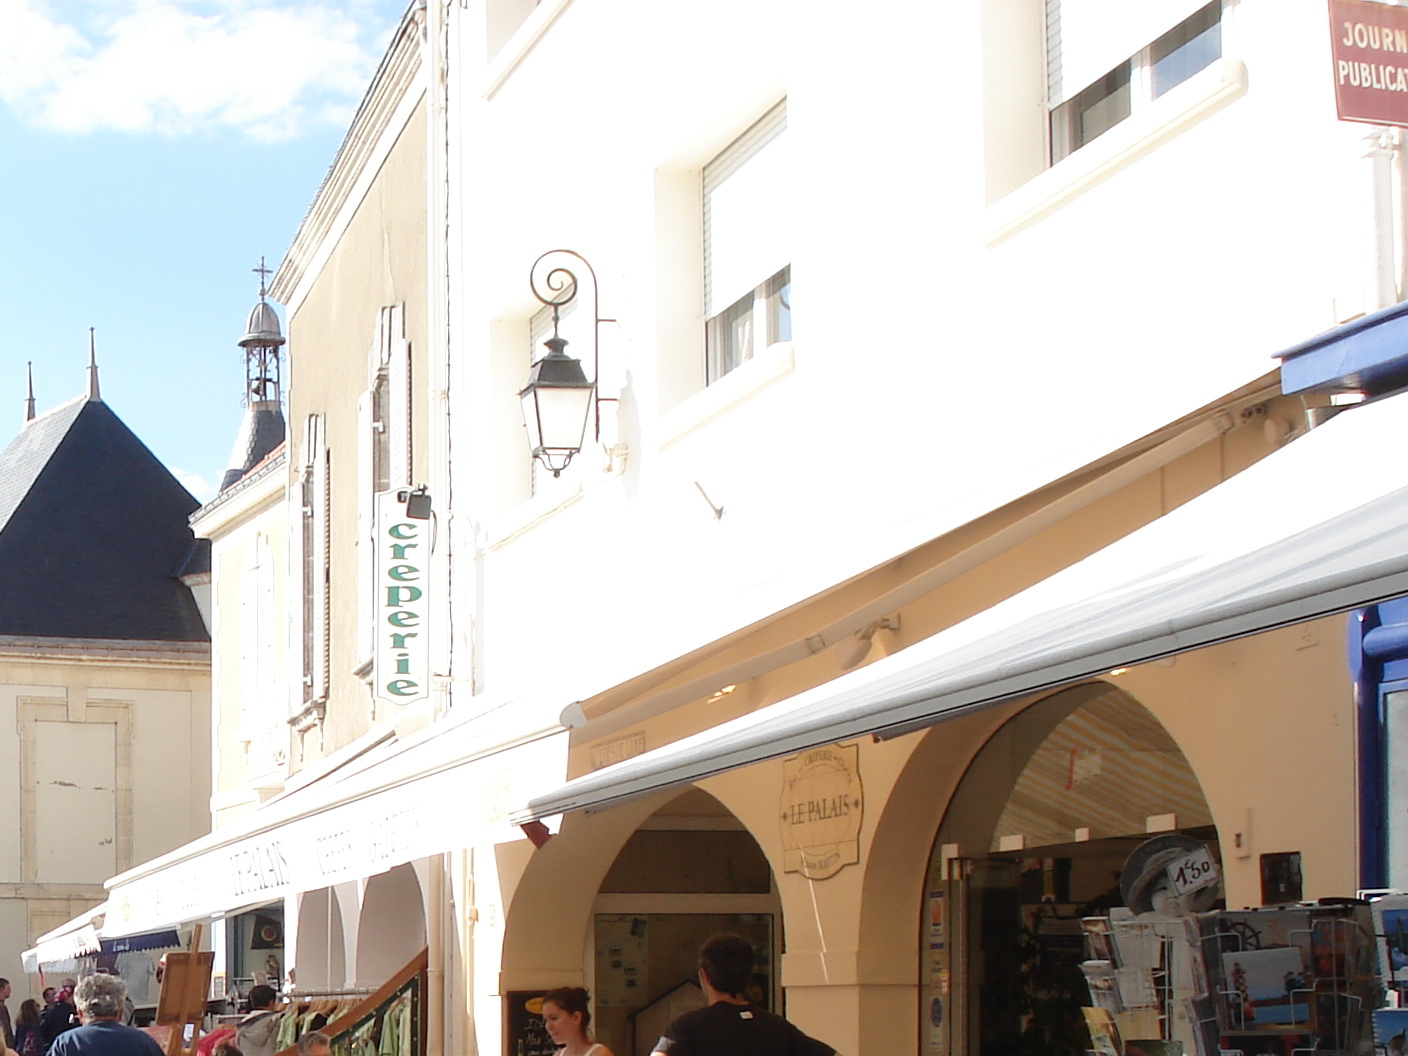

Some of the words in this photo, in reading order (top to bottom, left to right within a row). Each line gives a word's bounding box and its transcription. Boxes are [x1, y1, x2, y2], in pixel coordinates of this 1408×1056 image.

[384, 523, 423, 697] creperie
[791, 802, 805, 825] LE
[808, 794, 850, 822] PALAIS
